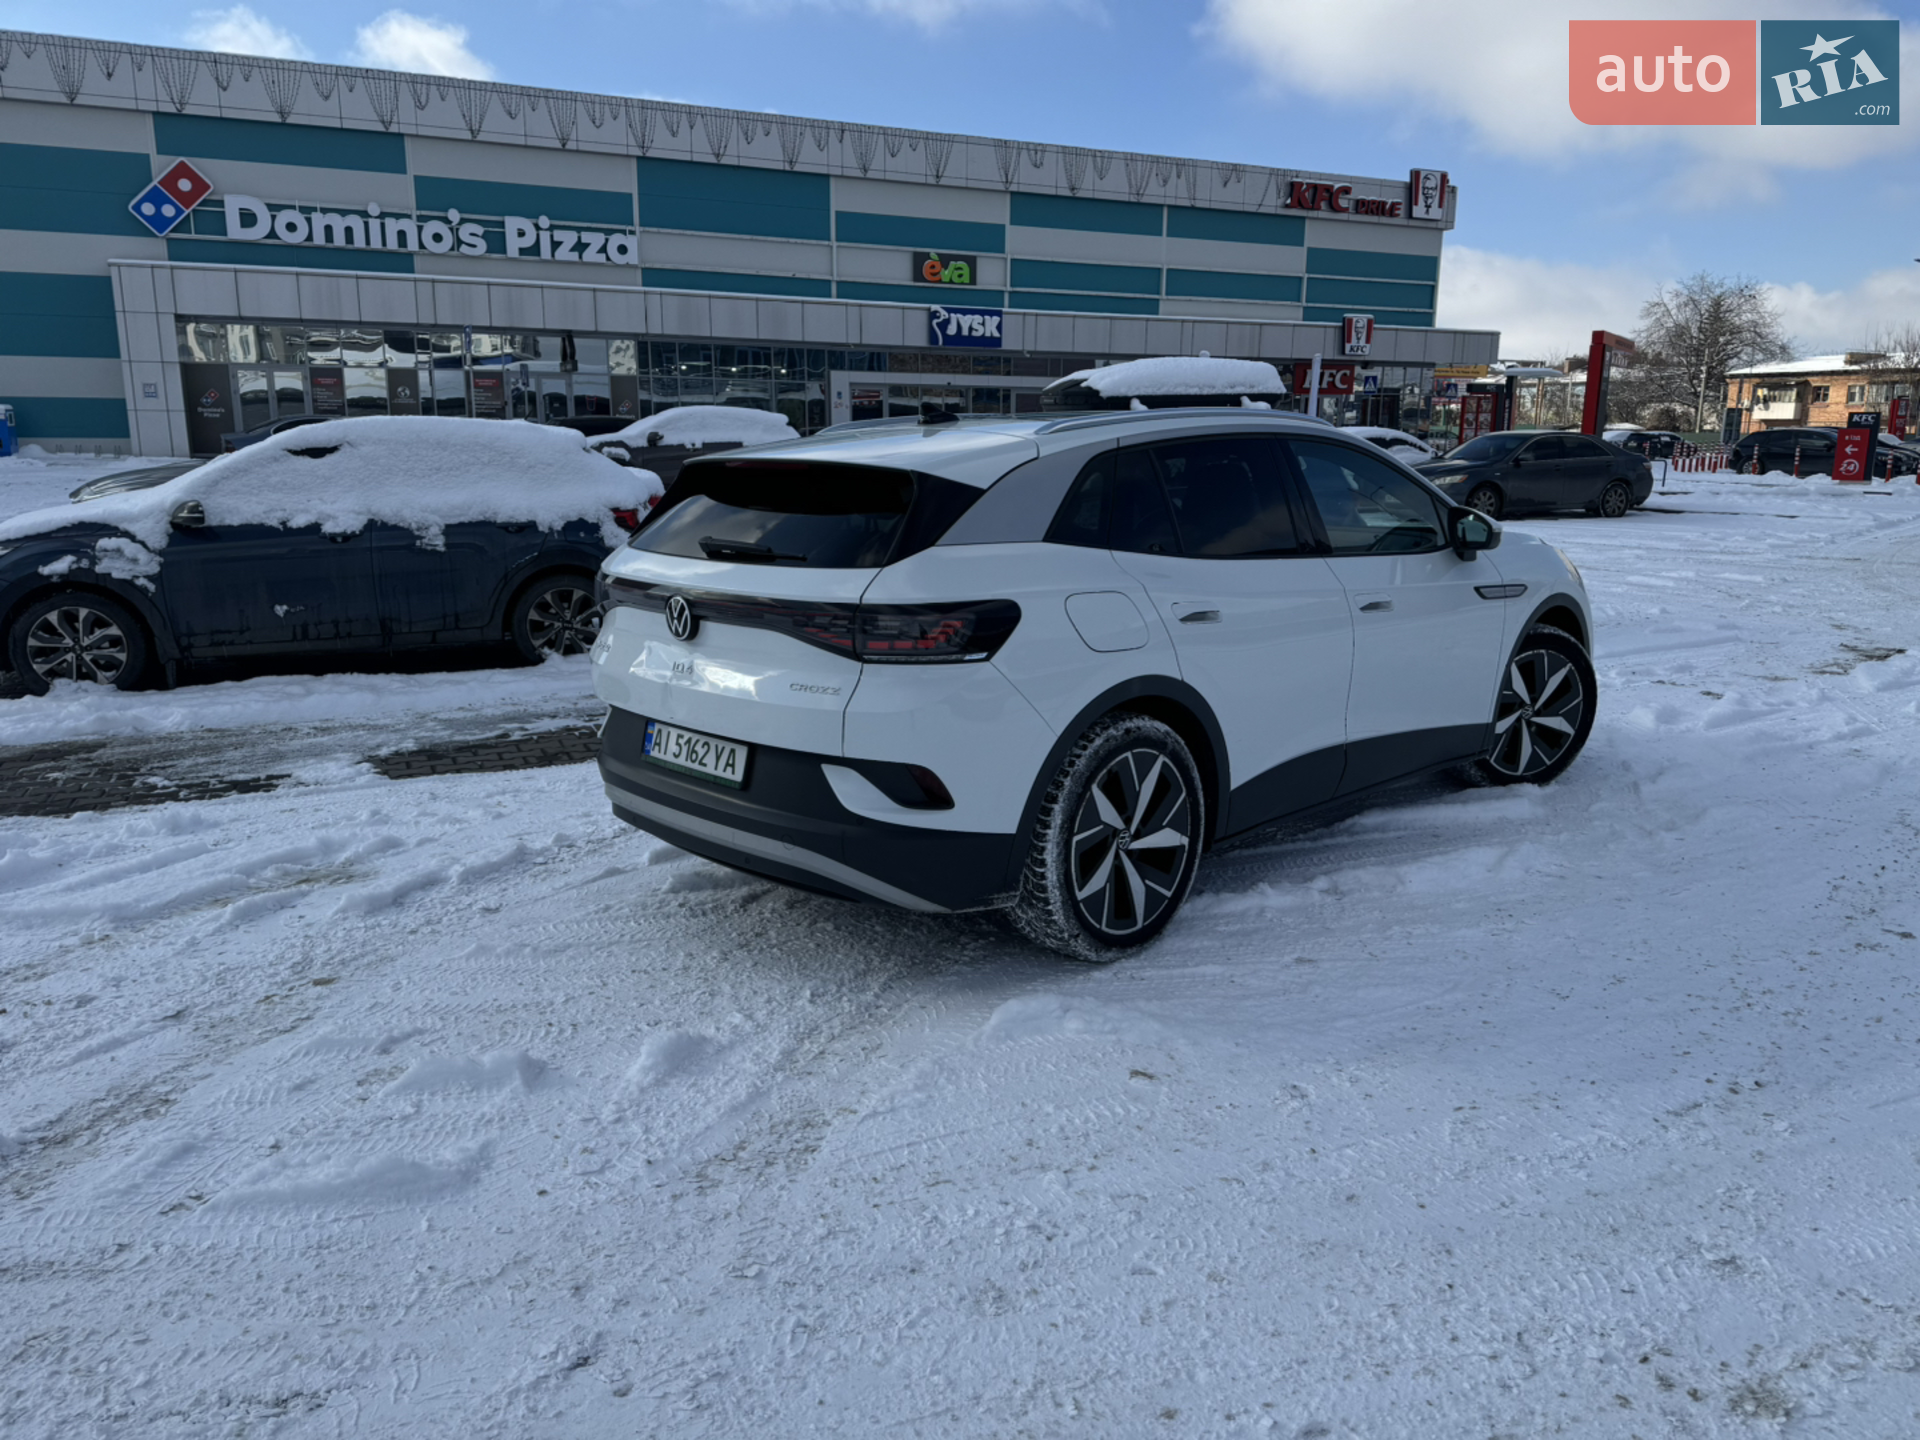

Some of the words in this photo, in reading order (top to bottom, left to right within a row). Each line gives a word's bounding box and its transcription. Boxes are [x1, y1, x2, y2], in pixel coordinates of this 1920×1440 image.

[1286, 178, 1353, 214] KFC
[1356, 196, 1404, 218] DRIVE
[223, 193, 488, 256] Domino's
[503, 214, 639, 265] Pizza
[945, 312, 1002, 338] JYSK
[1348, 344, 1368, 354] KFC
[1851, 414, 1877, 422] KFC
[788, 682, 842, 696] CROZZ
